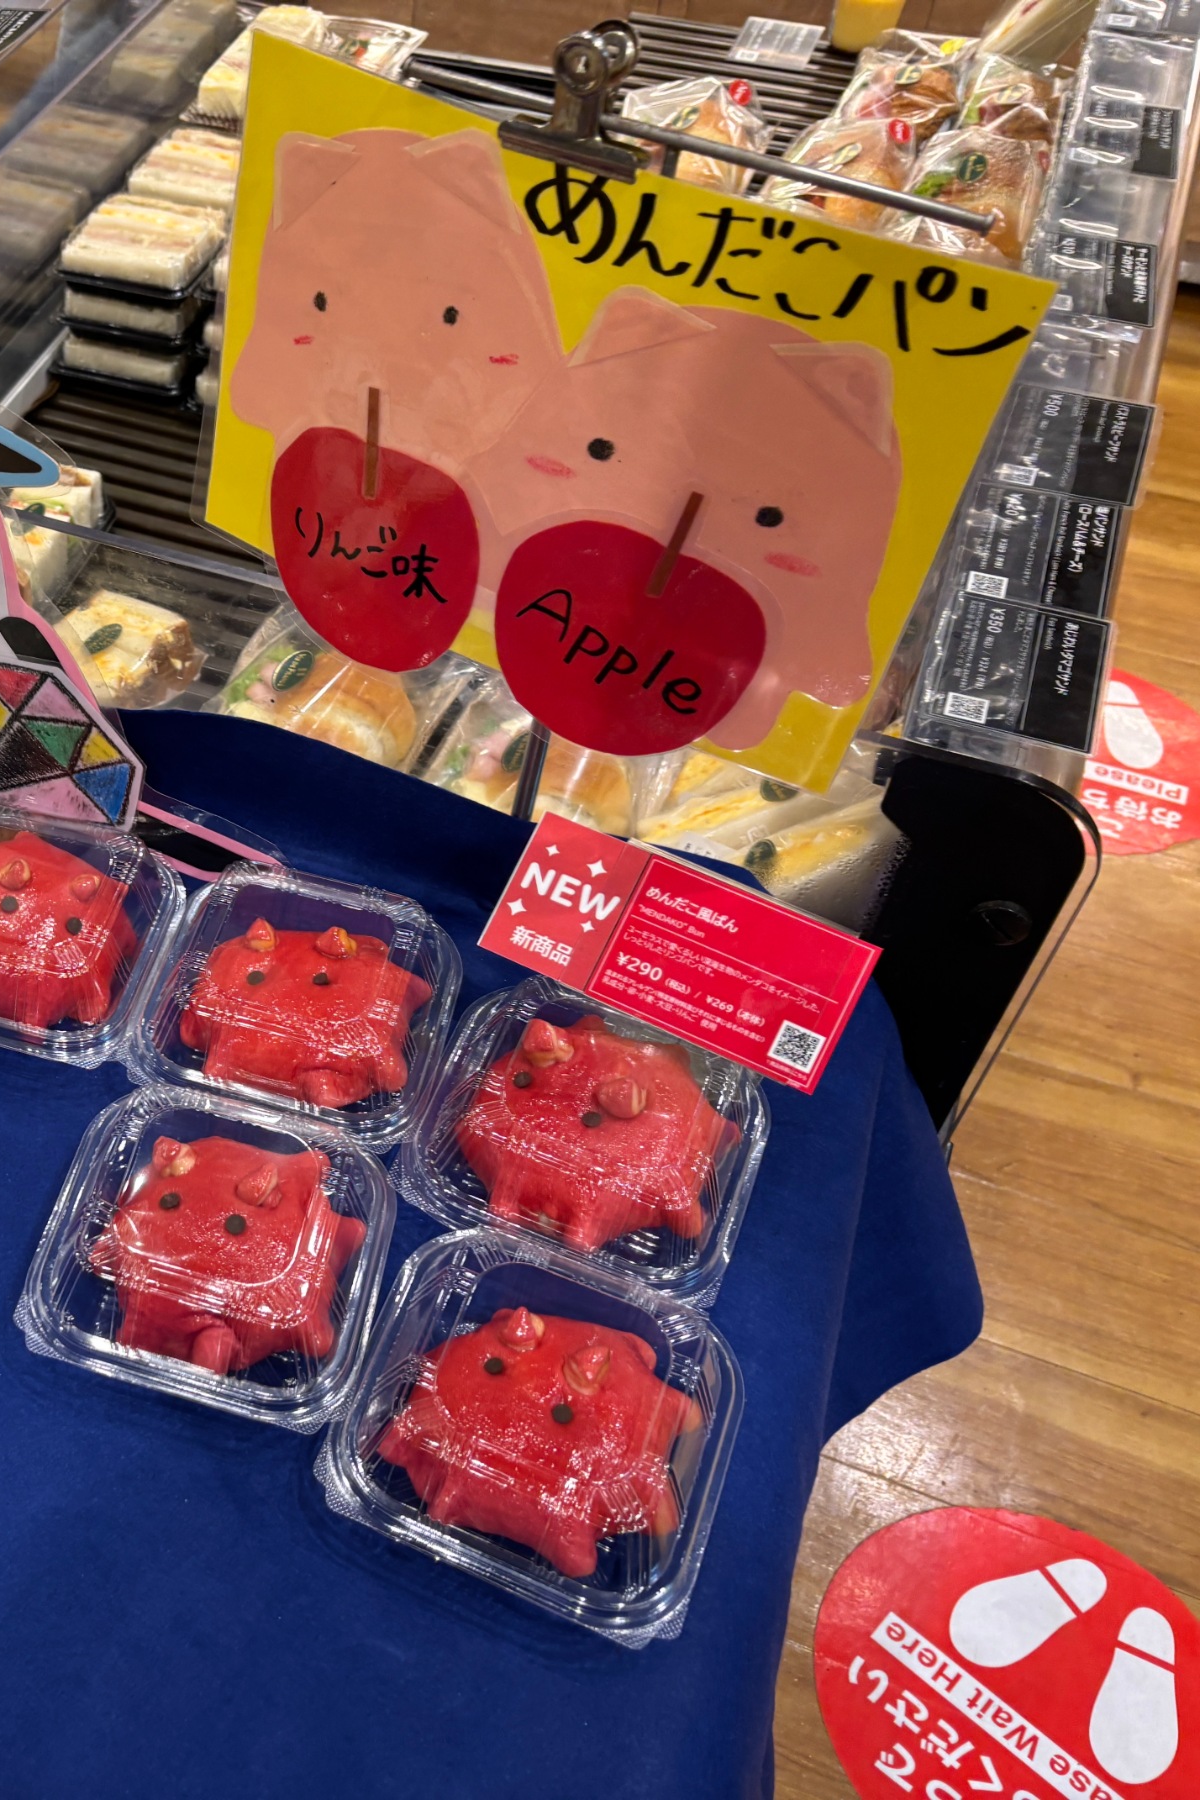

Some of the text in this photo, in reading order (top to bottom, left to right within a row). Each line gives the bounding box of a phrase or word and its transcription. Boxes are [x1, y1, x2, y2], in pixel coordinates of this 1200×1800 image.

[524, 163, 1030, 357] めんだこパン
[1041, 392, 1064, 417] ¥500
[295, 507, 447, 603] りんご味
[515, 588, 702, 715] Apple
[985, 606, 1006, 634] ¥350
[1052, 620, 1080, 696] あじわいタマゴサンド
[1094, 766, 1182, 801] Please
[520, 861, 621, 922] NEW
[509, 924, 574, 968] 新商品
[686, 924, 707, 939] Bun
[613, 950, 664, 982] ¥290
[703, 994, 735, 1014] ¥269
[884, 1621, 963, 1694] Here
[966, 1687, 1041, 1762] Wait
